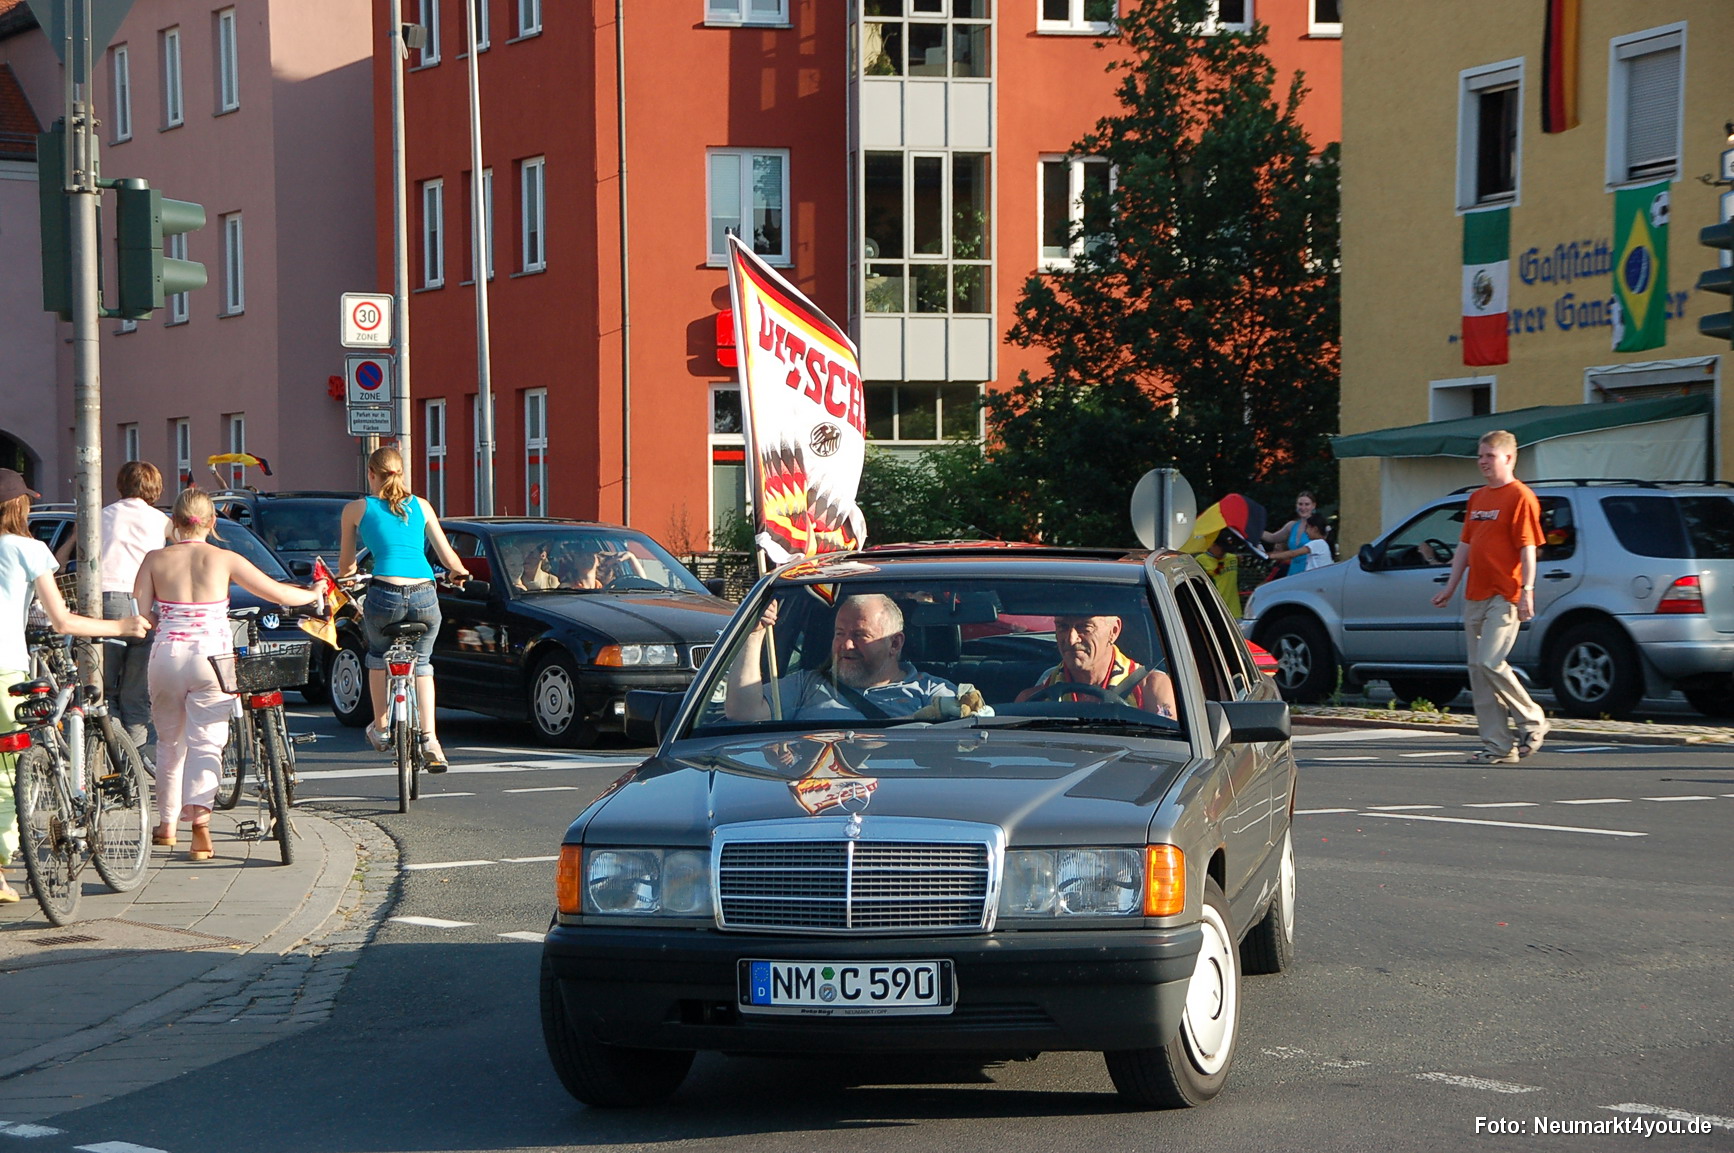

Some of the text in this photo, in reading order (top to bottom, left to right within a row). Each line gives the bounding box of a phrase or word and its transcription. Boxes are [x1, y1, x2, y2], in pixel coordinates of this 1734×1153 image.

[358, 309, 376, 323] 30
[356, 333, 379, 341] ZONE
[359, 392, 381, 400] ZONE
[758, 966, 935, 1000] D NM C 590
